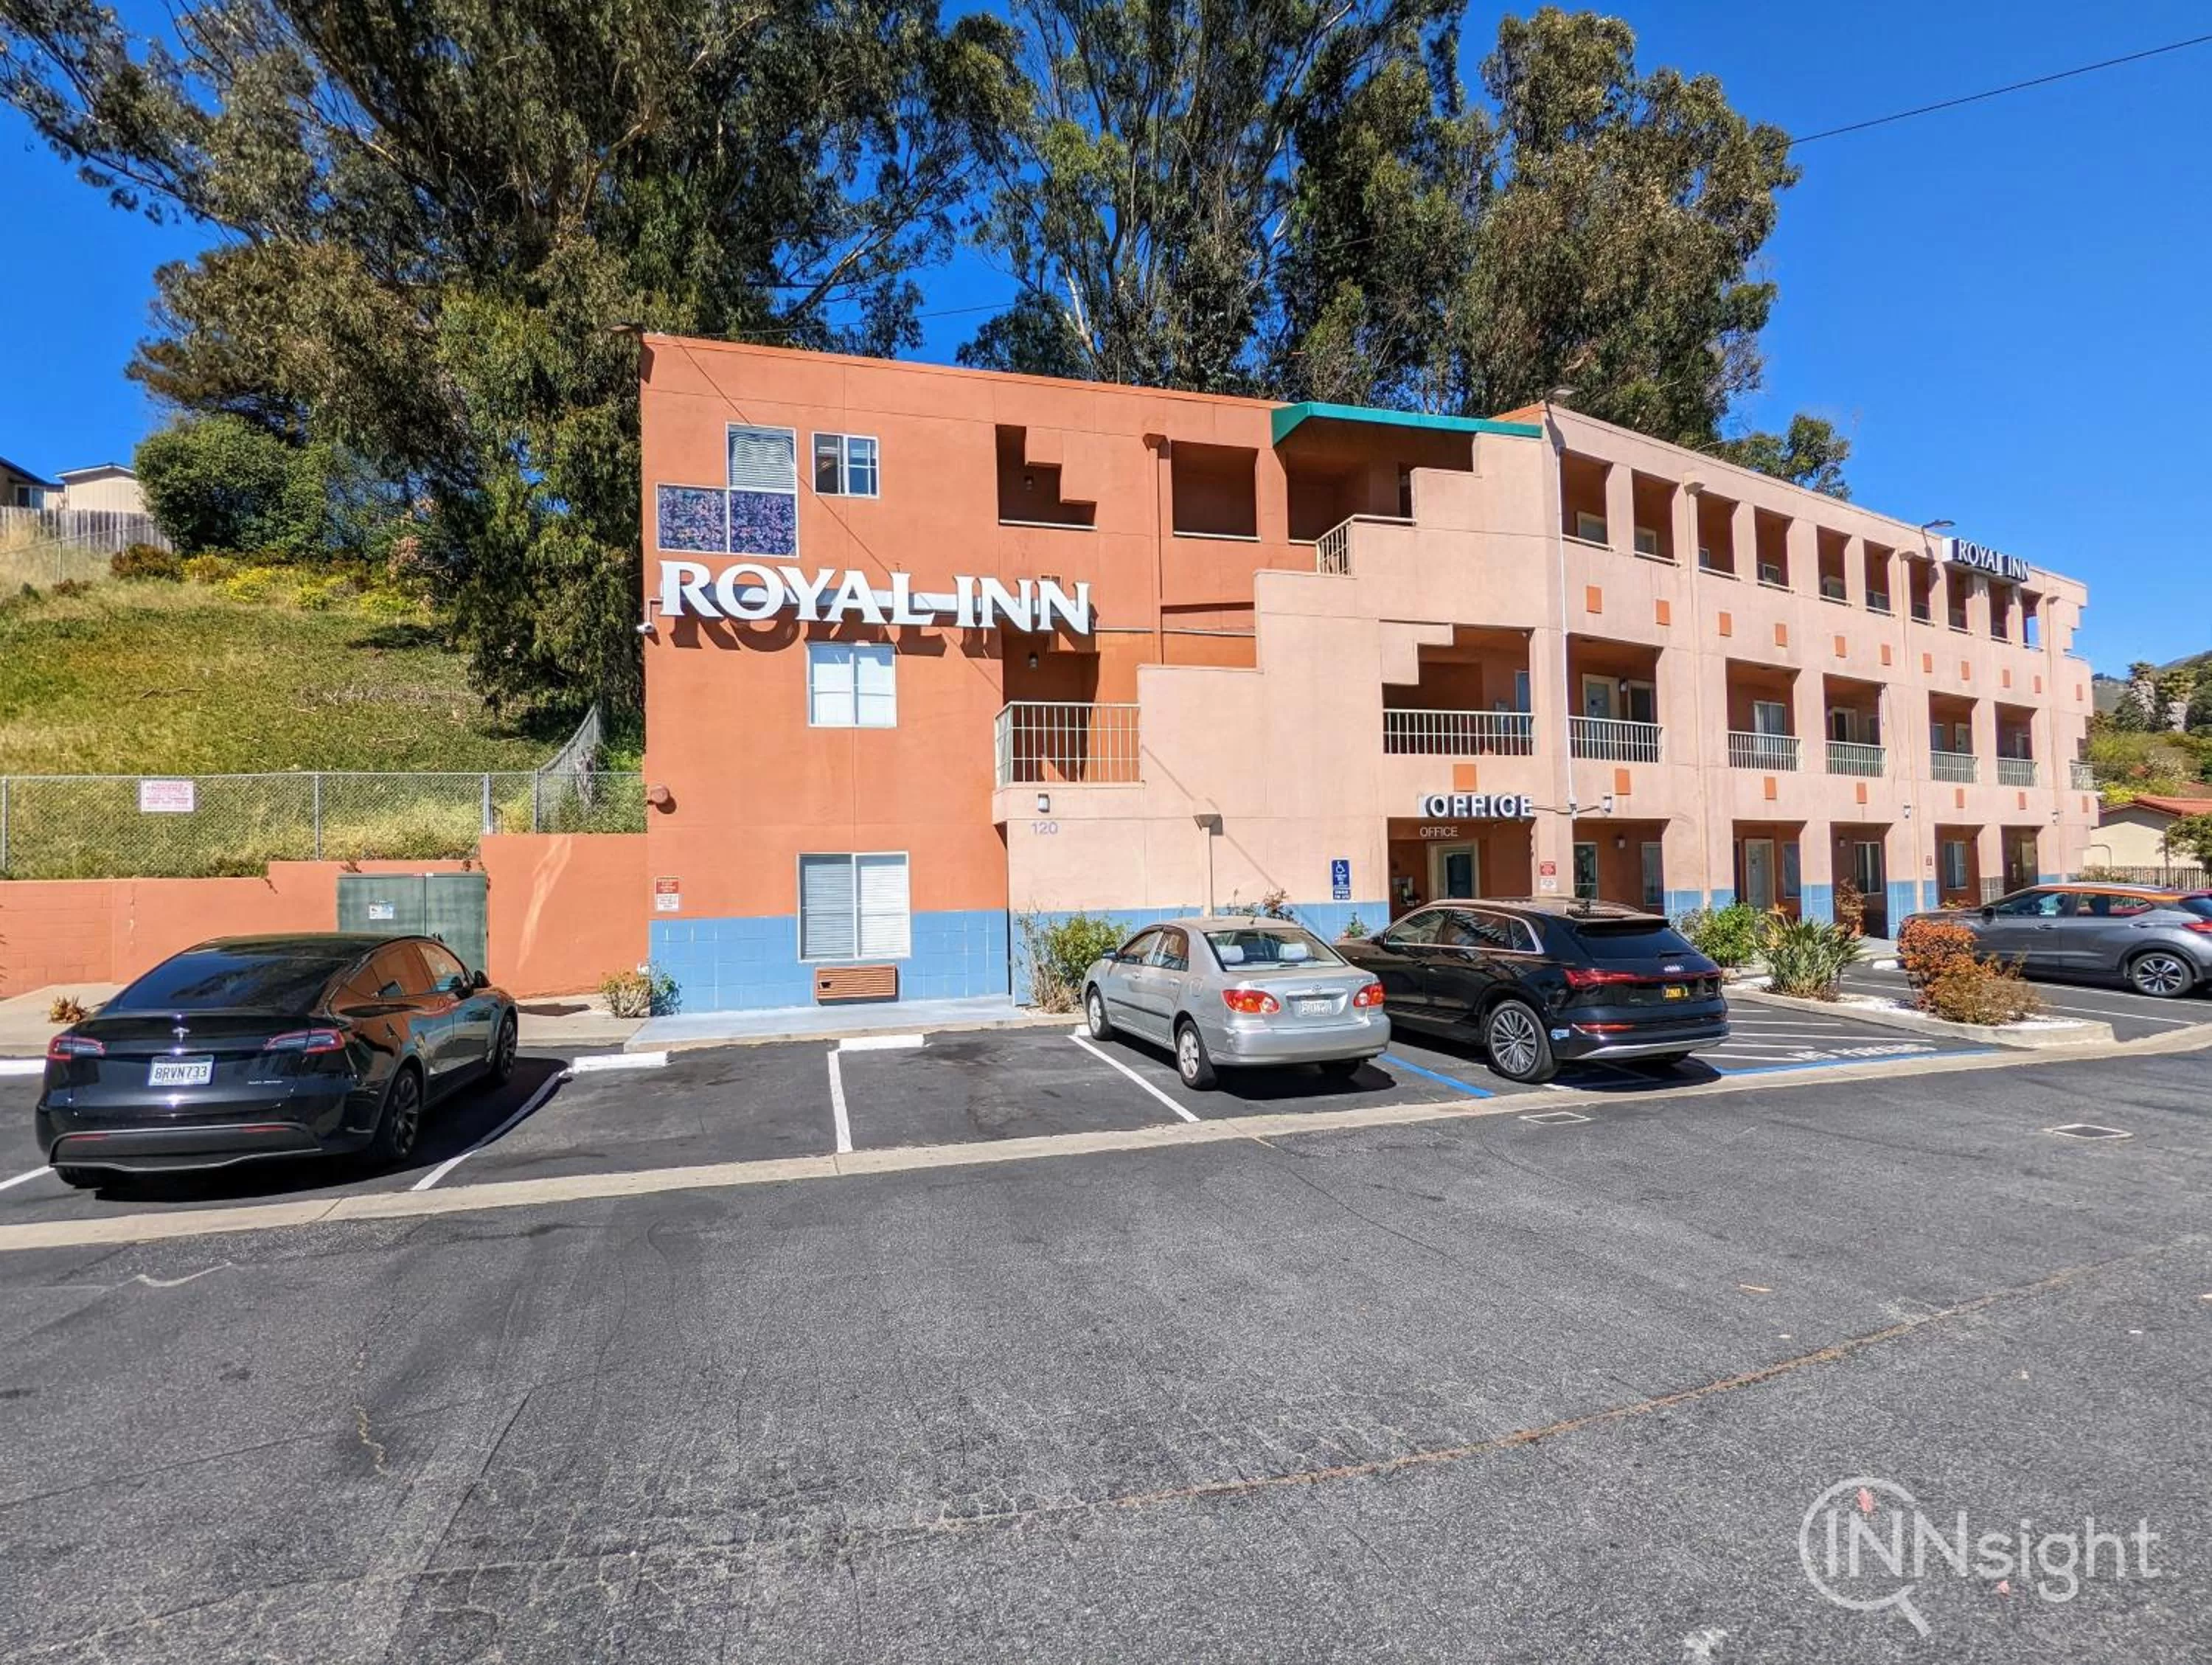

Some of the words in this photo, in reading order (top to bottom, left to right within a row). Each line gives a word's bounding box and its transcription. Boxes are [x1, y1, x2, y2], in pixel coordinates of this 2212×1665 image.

[1958, 538, 2004, 574] ROYAL
[2008, 555, 2030, 580] INN
[659, 560, 935, 625] ROYAL
[954, 574, 1091, 635] INN
[1429, 795, 1534, 818] OFFICE
[1031, 821, 1059, 835] 120
[1419, 826, 1459, 838] OFFICE
